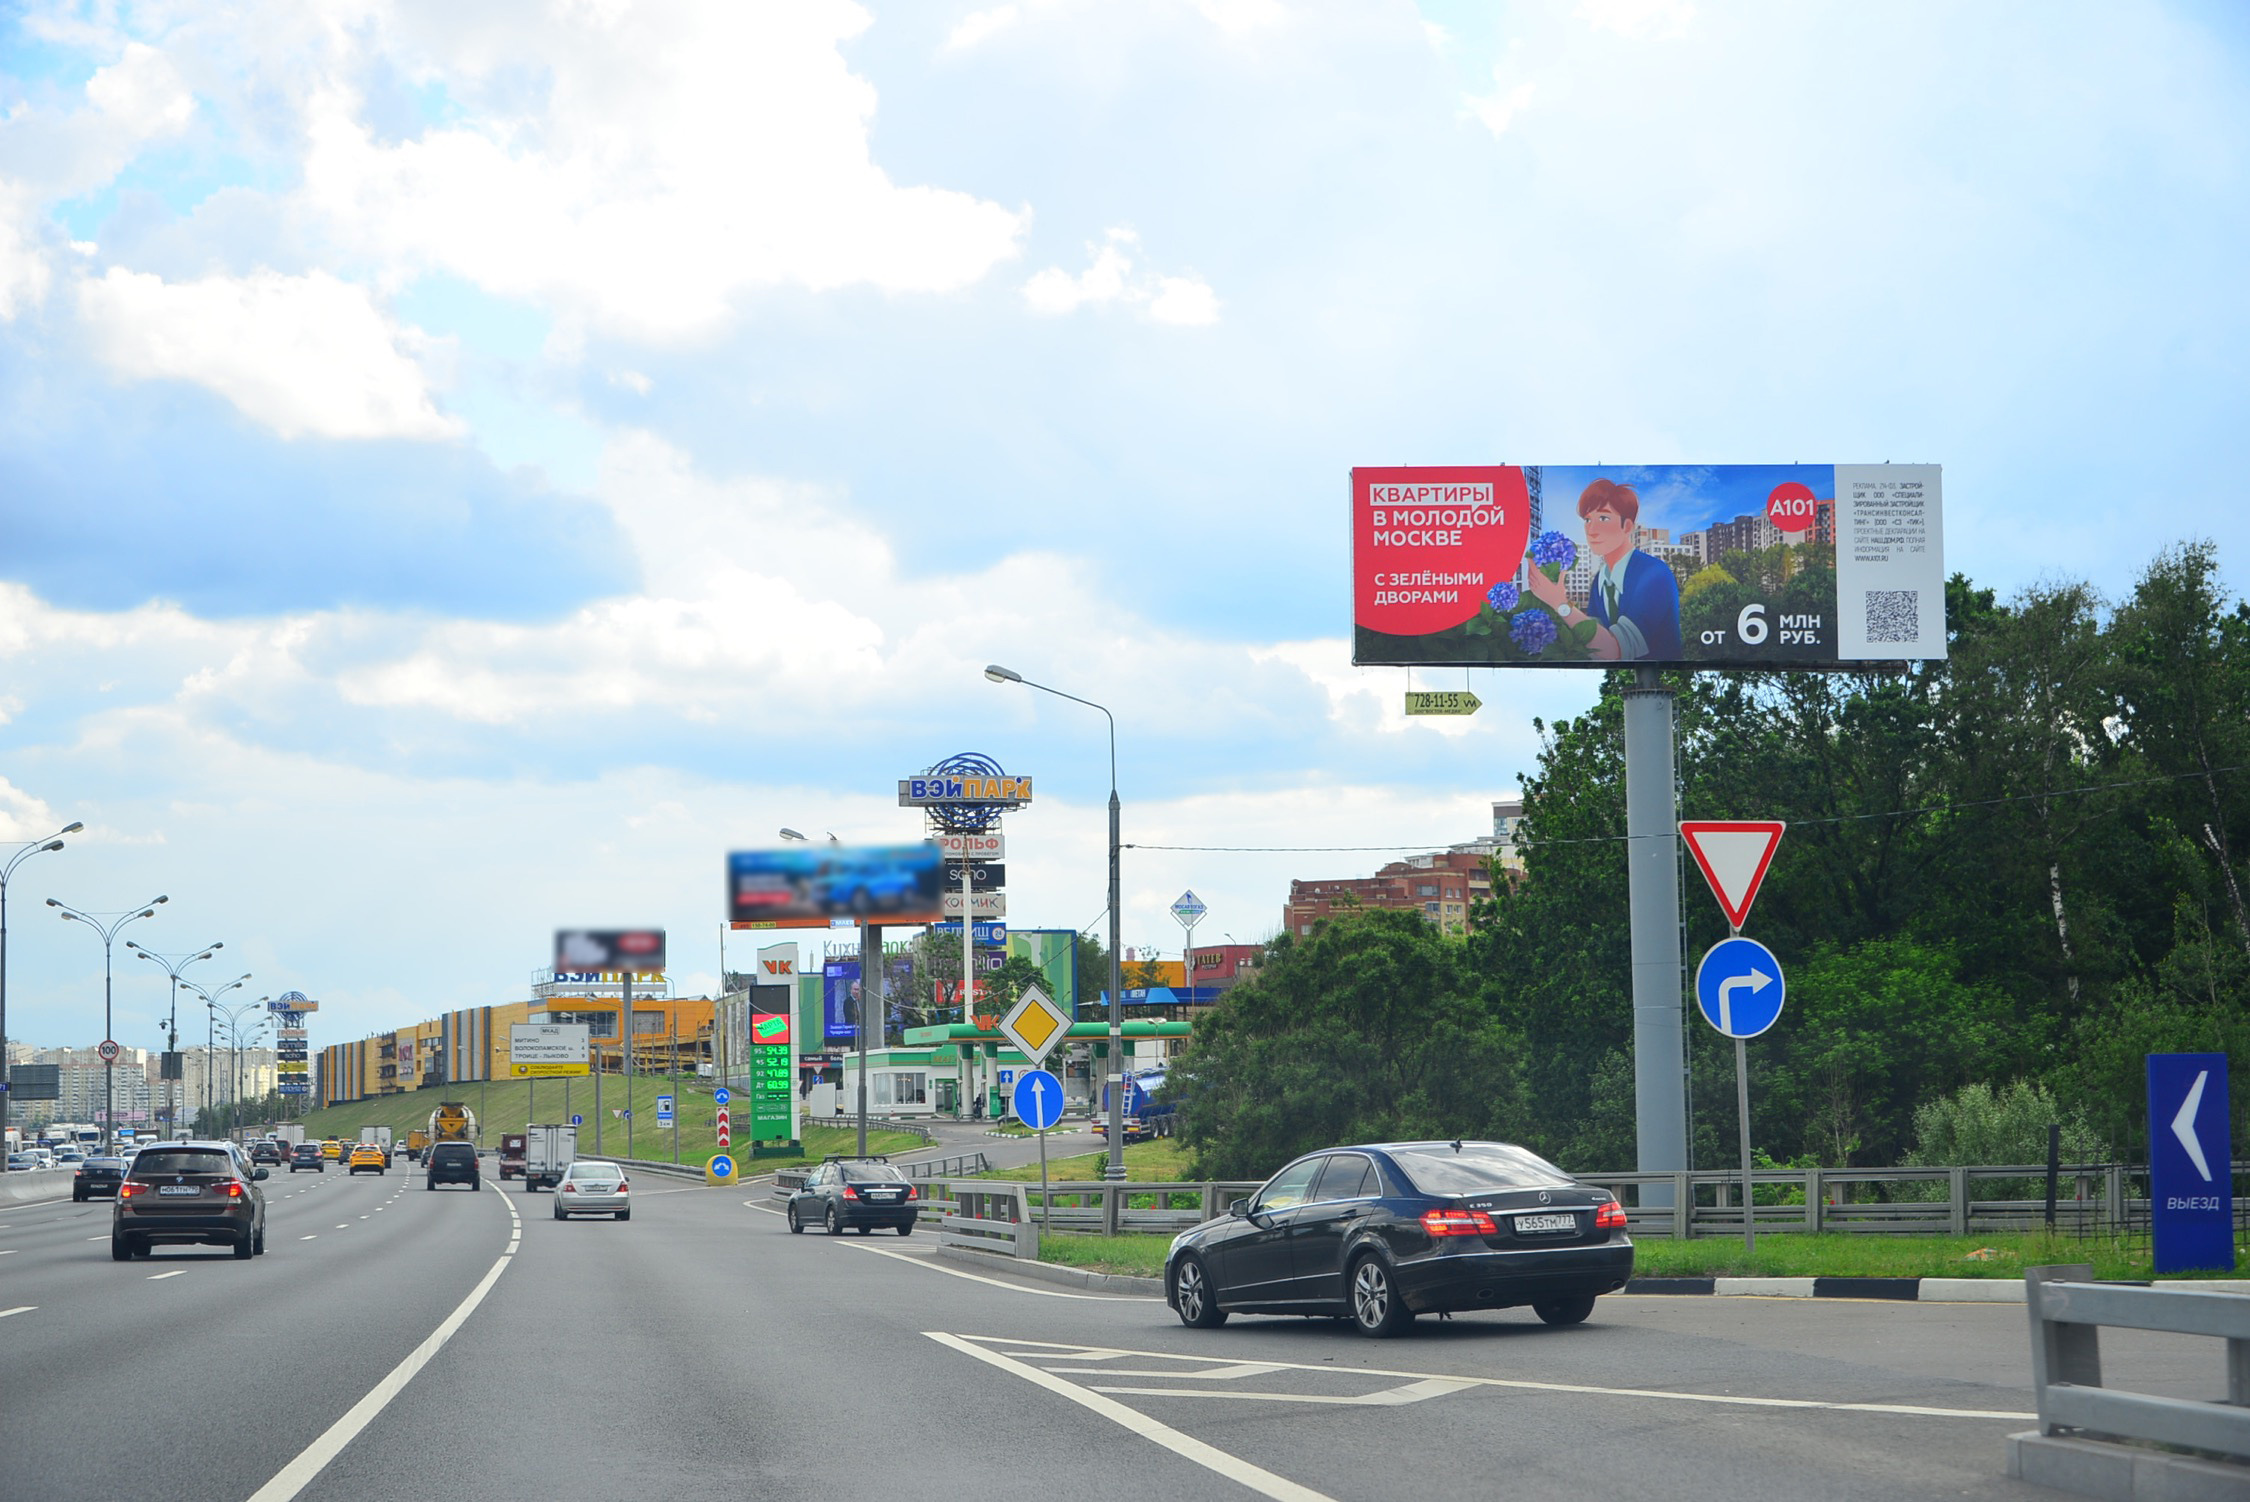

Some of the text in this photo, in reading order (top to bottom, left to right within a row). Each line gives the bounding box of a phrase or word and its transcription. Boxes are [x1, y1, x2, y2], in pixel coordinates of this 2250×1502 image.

[1373, 487, 1490, 502] КВАРТИРЫ
[1373, 505, 1505, 529] В МОЛОДОЙ
[1373, 530, 1463, 546] МОСКВЕ
[1374, 569, 1484, 586] С ЗЕЛЁНЫМИ
[1374, 590, 1458, 606] ДВОРАМИ
[1700, 603, 1821, 645] ОТ 6 МЛН
[1779, 631, 1821, 644] РУБ.
[1414, 693, 1458, 708] 728-11-55
[911, 776, 1031, 798] ВЭЙПАРК
[102, 1046, 116, 1054] 100
[2167, 1196, 2220, 1211] ВЫЕЗД
